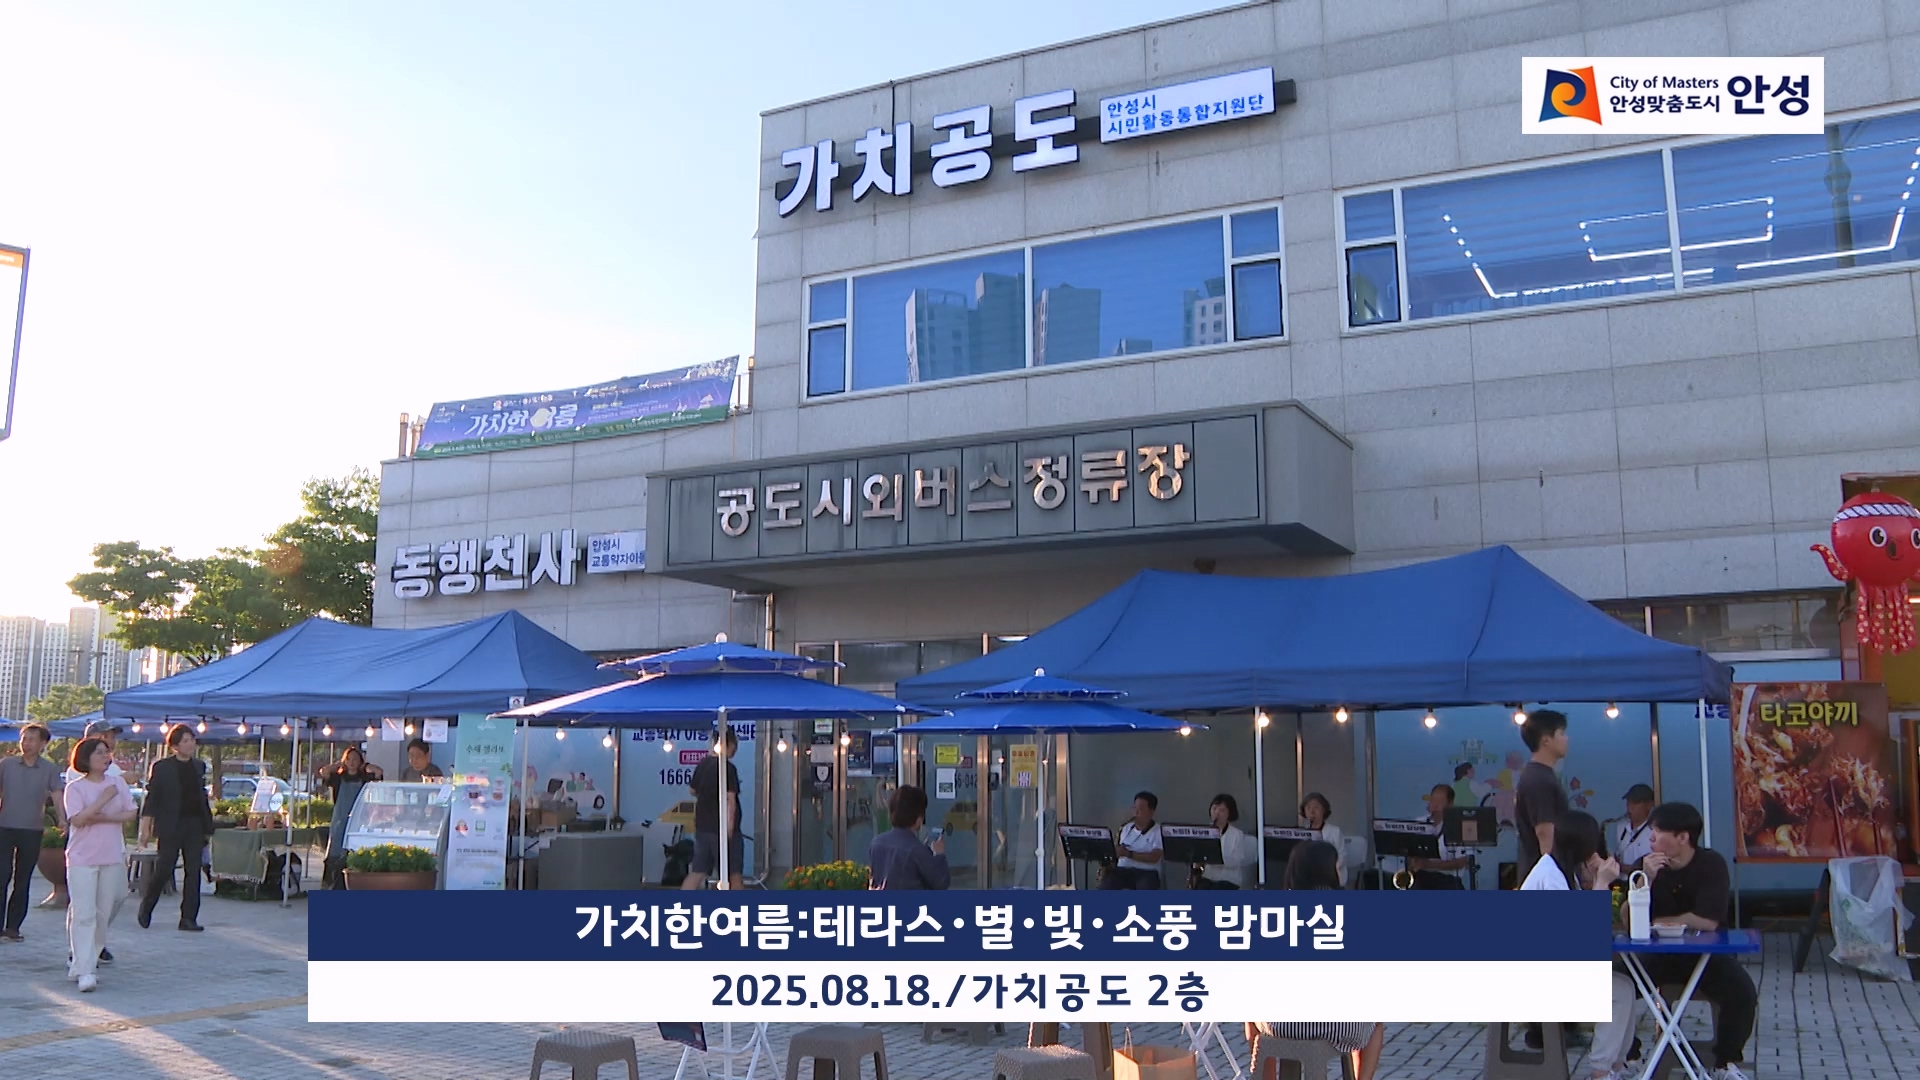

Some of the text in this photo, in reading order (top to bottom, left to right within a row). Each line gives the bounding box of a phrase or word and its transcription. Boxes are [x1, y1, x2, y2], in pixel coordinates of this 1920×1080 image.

[1108, 94, 1156, 118] 안성시
[1108, 94, 1264, 135] 시민활동통합지원단
[777, 89, 1079, 218] 가치공도
[716, 444, 1192, 537] 공도시외버스정류장
[392, 529, 581, 599] 동행천사
[592, 537, 620, 553] 안성시
[1760, 702, 1858, 727] 타코야끼
